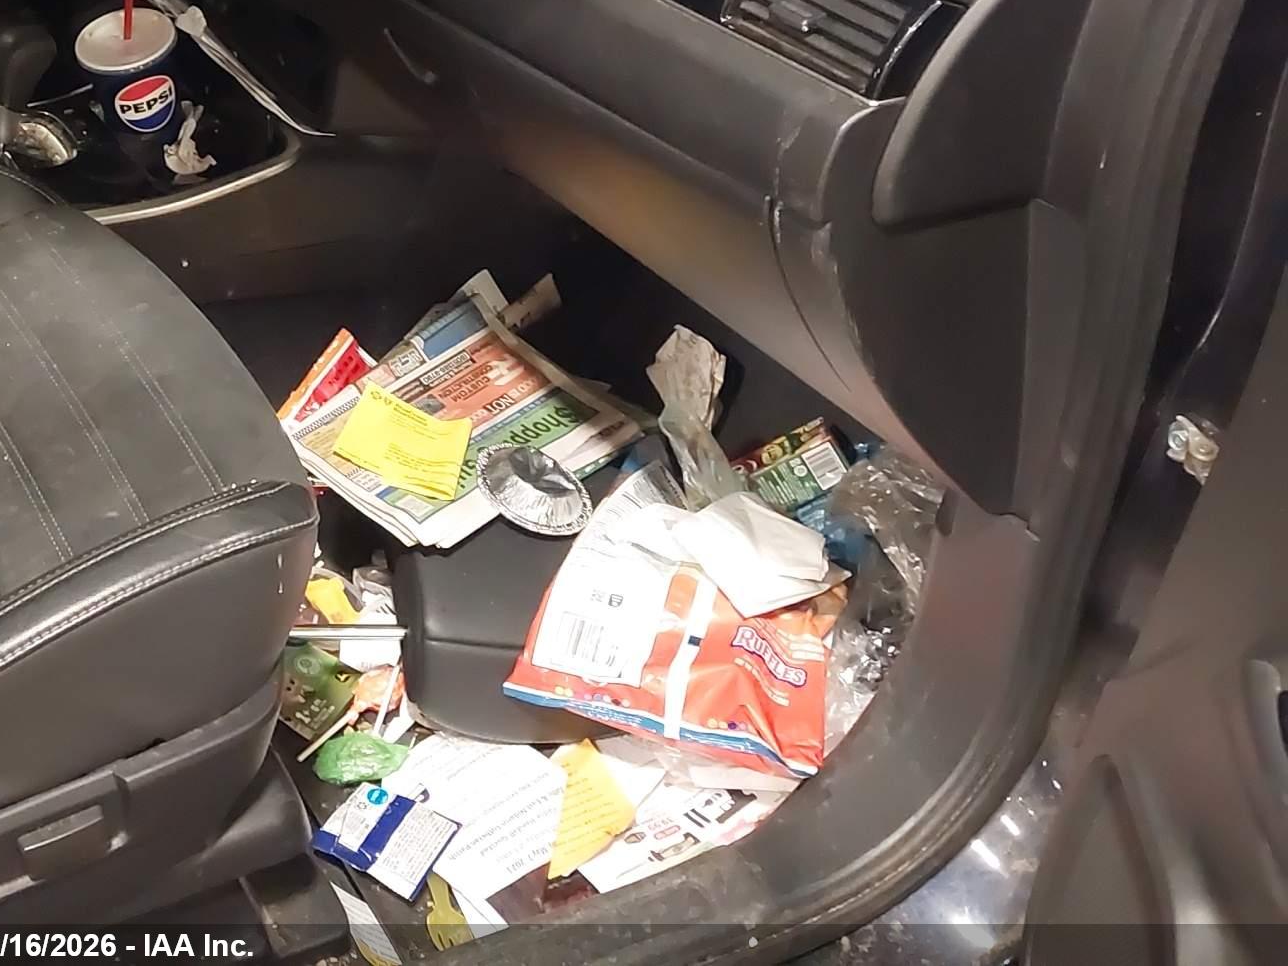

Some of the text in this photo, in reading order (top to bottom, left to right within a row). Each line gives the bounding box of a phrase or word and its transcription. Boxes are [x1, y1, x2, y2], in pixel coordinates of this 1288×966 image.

[119, 85, 172, 114] PEPSI
[451, 376, 491, 402] CUSTOM
[486, 393, 515, 415] NOT
[736, 627, 803, 684] RUFFLES
